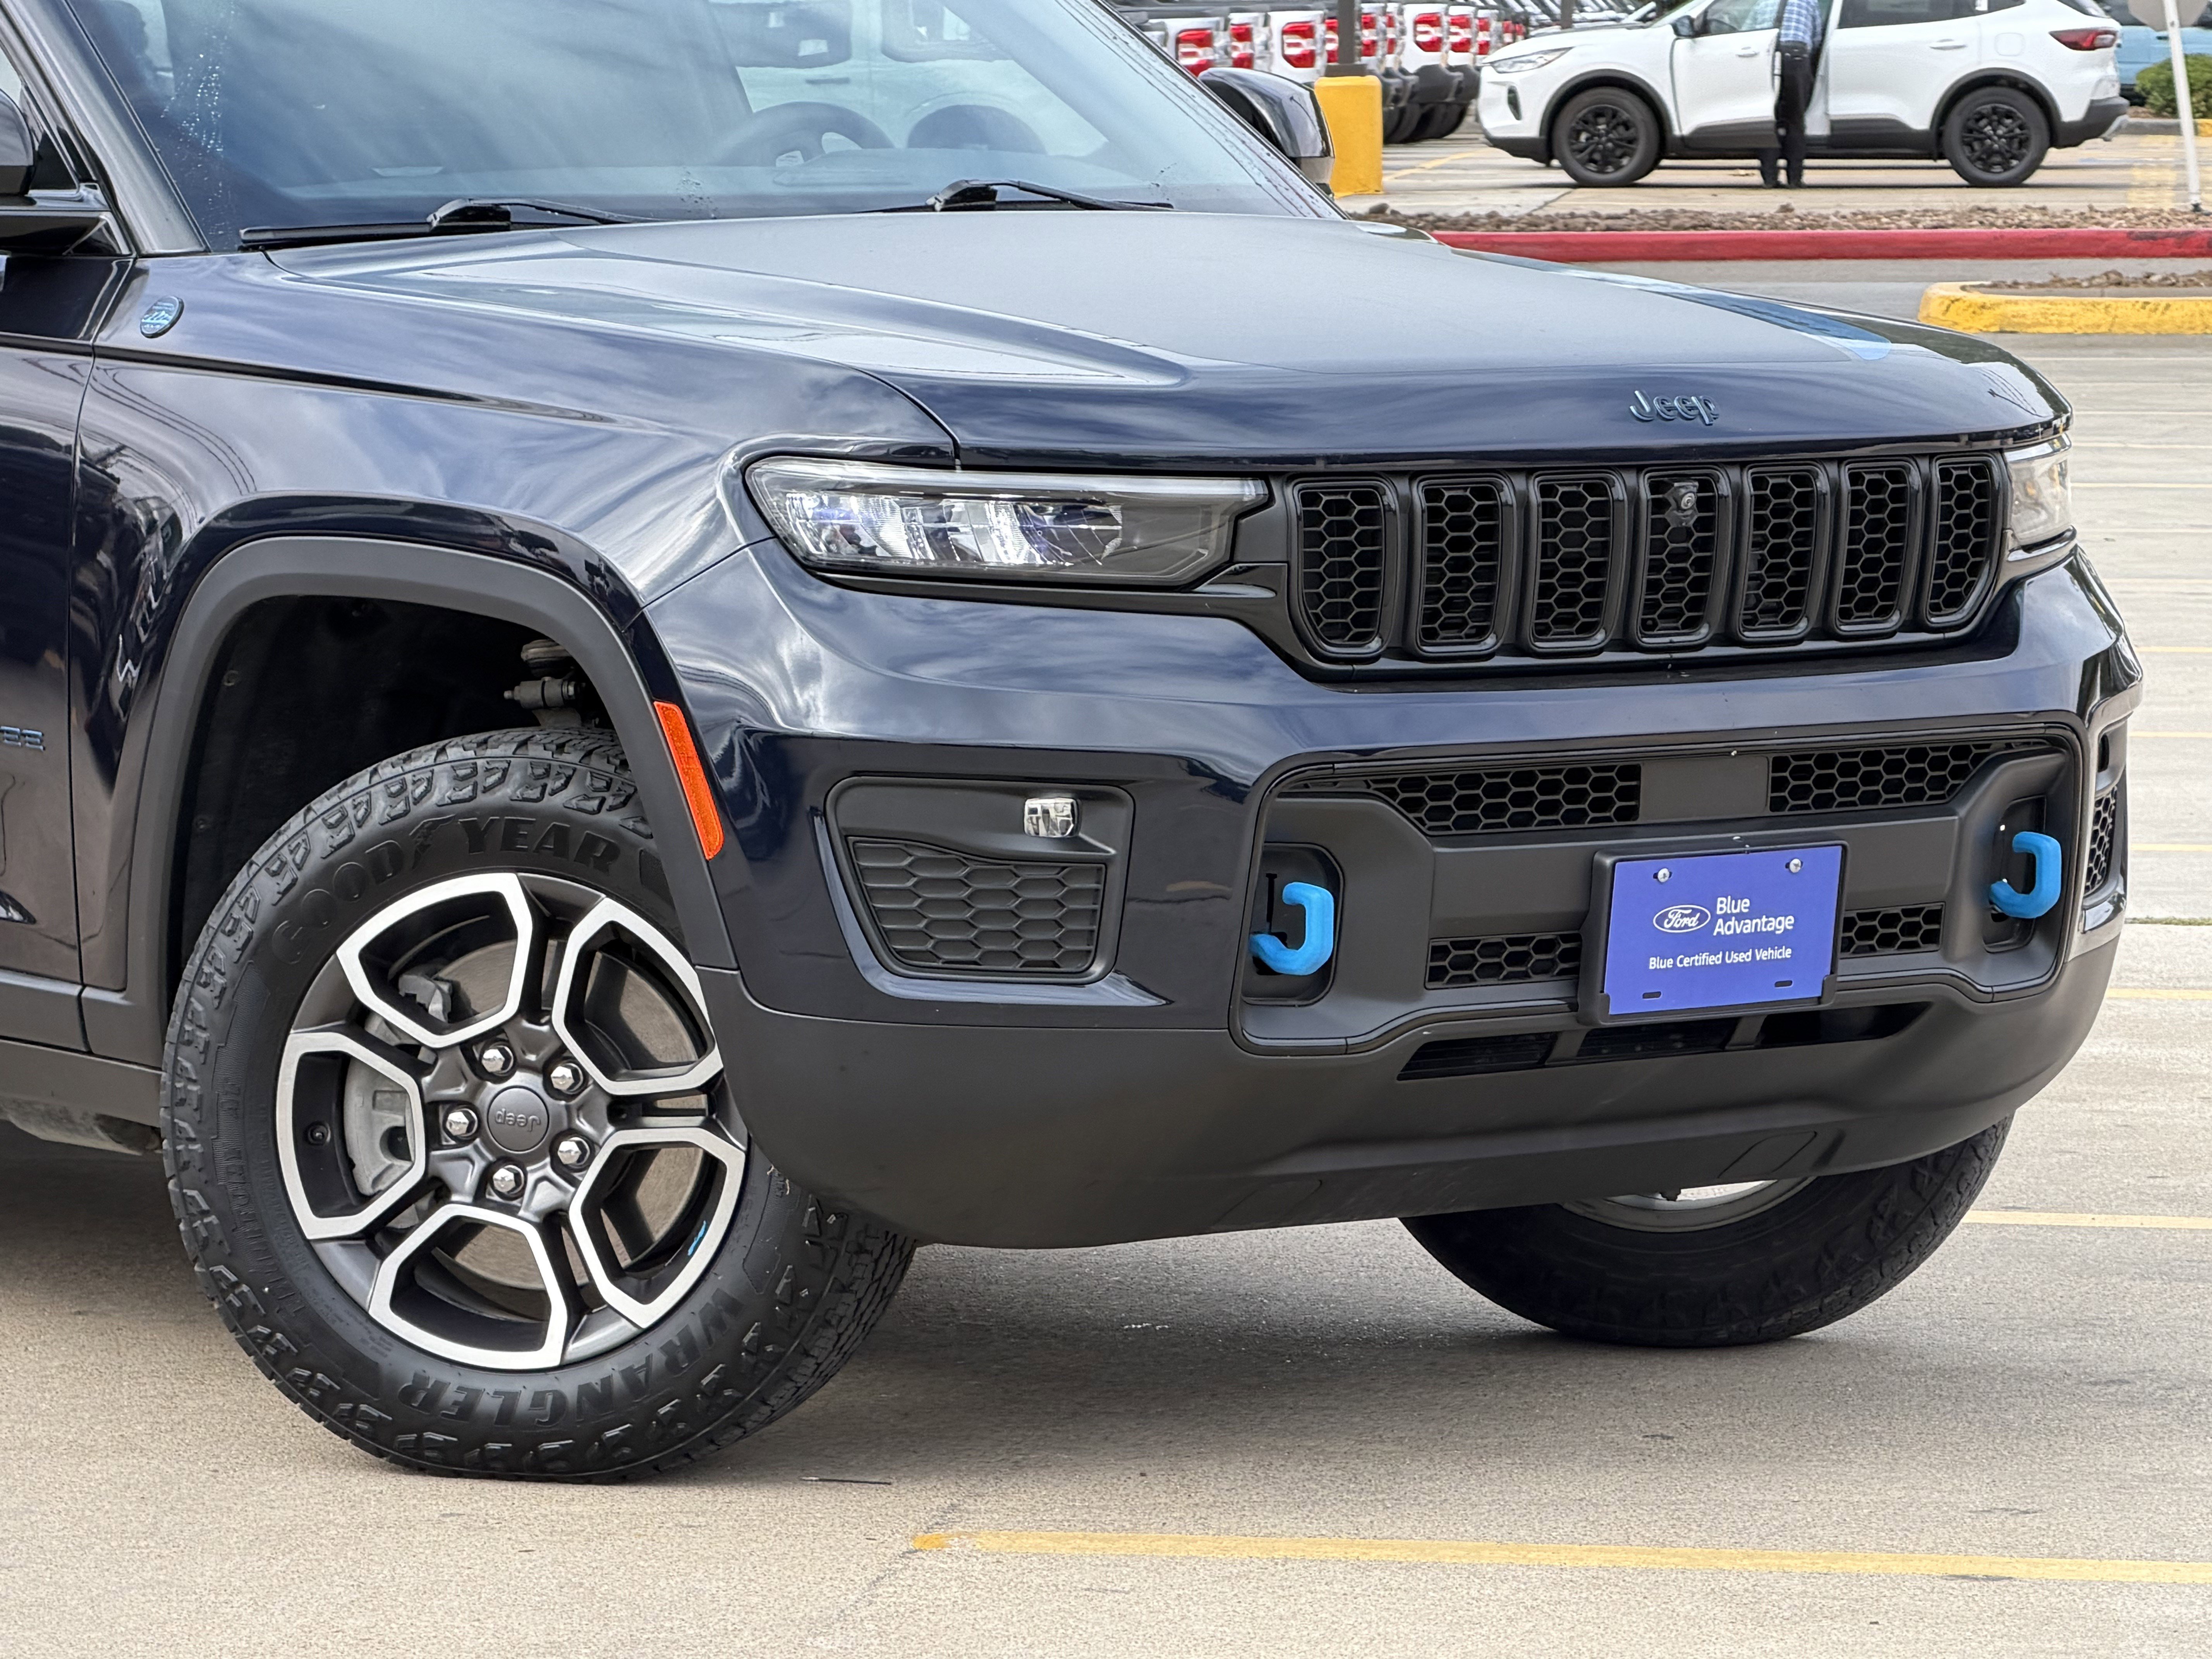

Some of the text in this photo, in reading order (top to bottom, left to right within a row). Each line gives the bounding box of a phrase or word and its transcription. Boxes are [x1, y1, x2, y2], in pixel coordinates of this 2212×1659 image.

[1629, 390, 1720, 426] Jeep
[1716, 895, 1750, 914] Blue
[1664, 909, 1700, 929] Ford
[1713, 915, 1795, 936] Advantage
[1649, 945, 1792, 969] Blue Certified Used Vehicle
[495, 1108, 541, 1132] Jeep
[398, 1287, 747, 1428] WRANGLER
